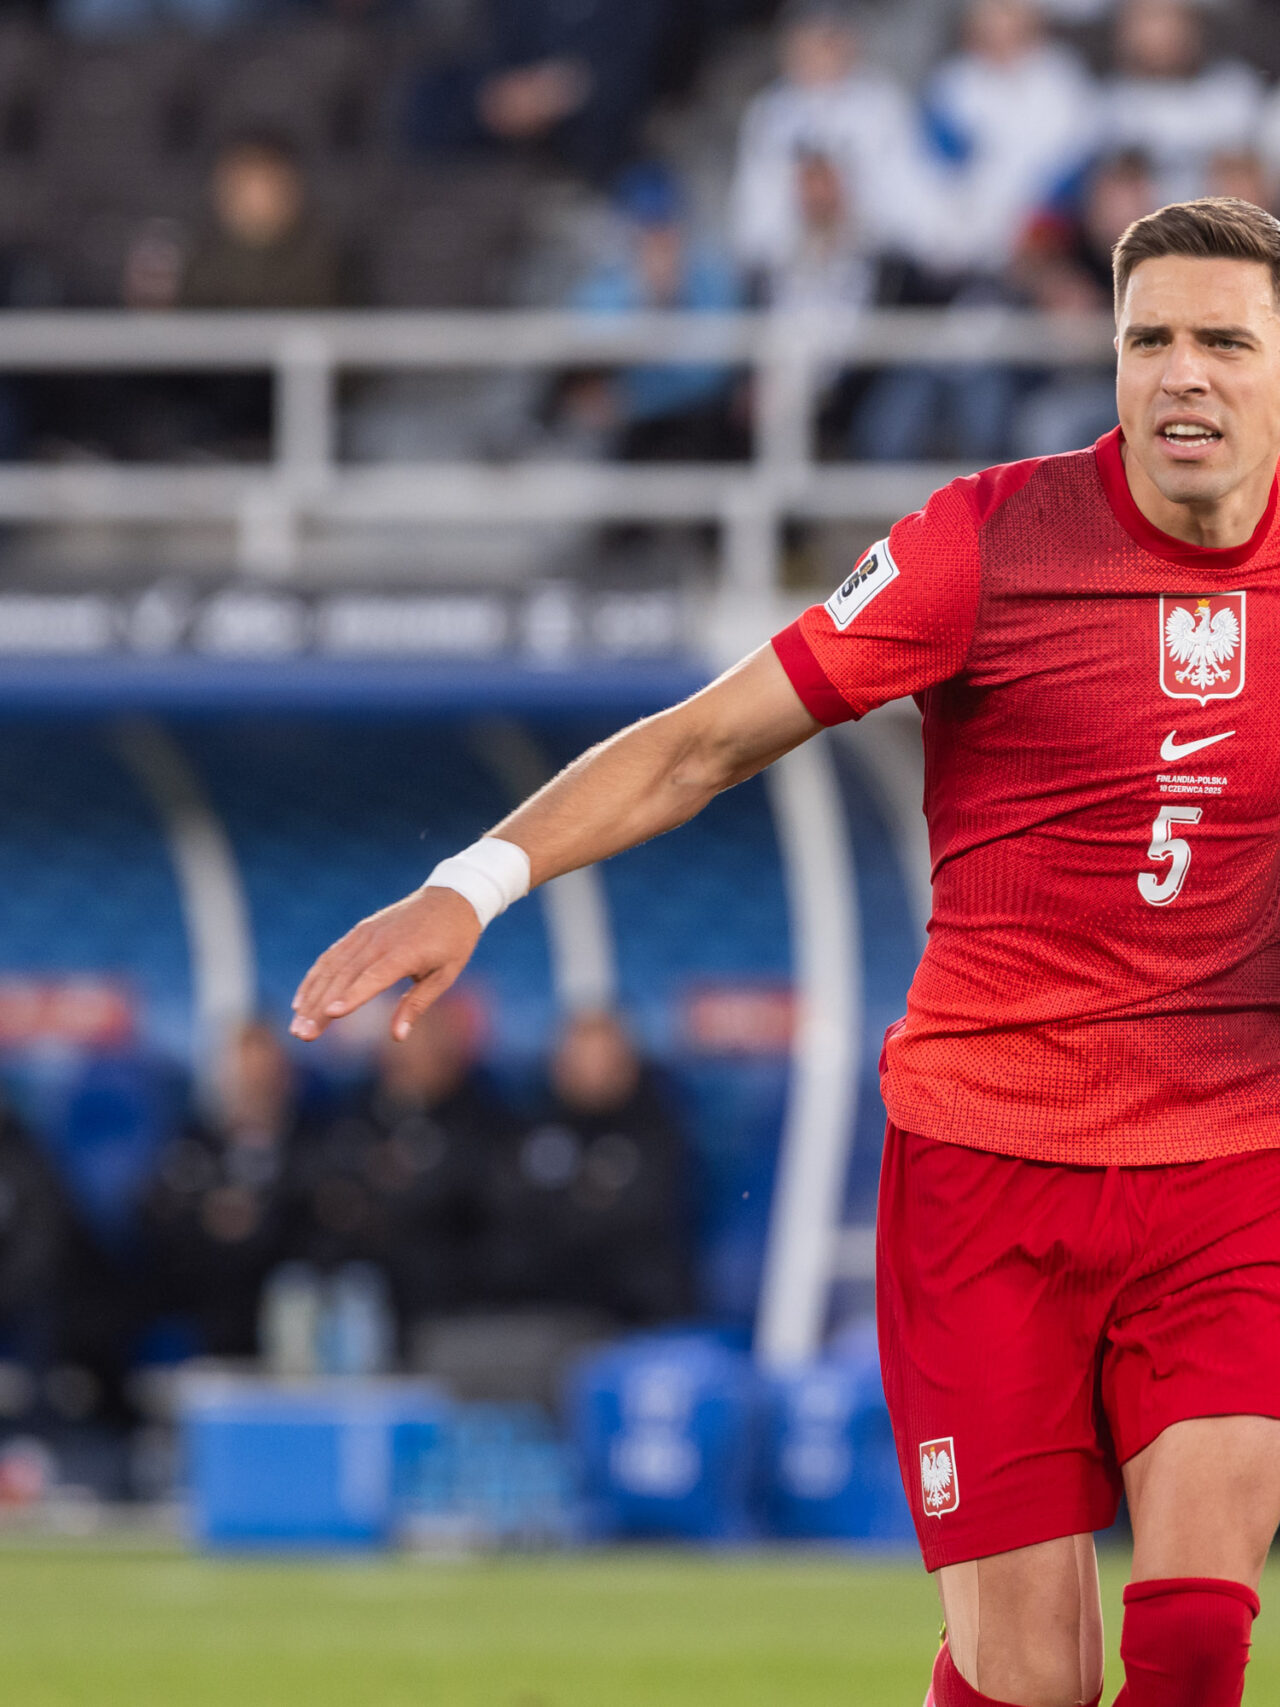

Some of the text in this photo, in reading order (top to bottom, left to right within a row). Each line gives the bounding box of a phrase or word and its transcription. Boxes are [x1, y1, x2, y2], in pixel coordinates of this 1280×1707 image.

[1156, 774, 1228, 785] FINLANDIA-POLSKA
[1159, 784, 1222, 795] 10 CZERWCA 2025
[1137, 805, 1204, 907] 5
